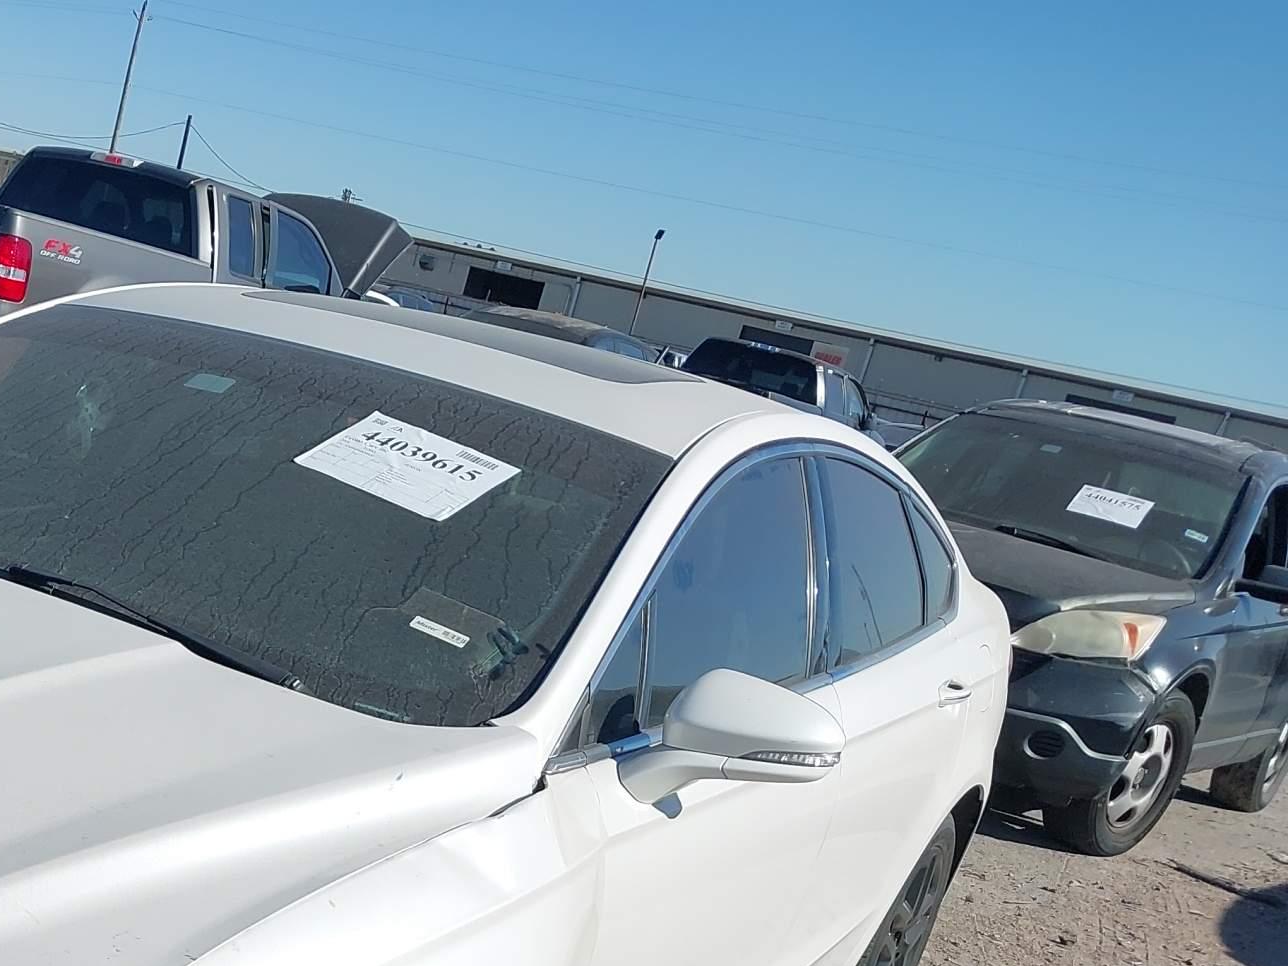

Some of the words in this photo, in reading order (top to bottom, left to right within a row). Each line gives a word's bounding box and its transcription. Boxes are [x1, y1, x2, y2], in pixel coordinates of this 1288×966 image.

[40, 250, 57, 258] OFF
[57, 254, 81, 265] ROAD
[44, 239, 82, 258] FX4
[362, 430, 483, 482] 44039615
[1085, 492, 1142, 511] 44041575
